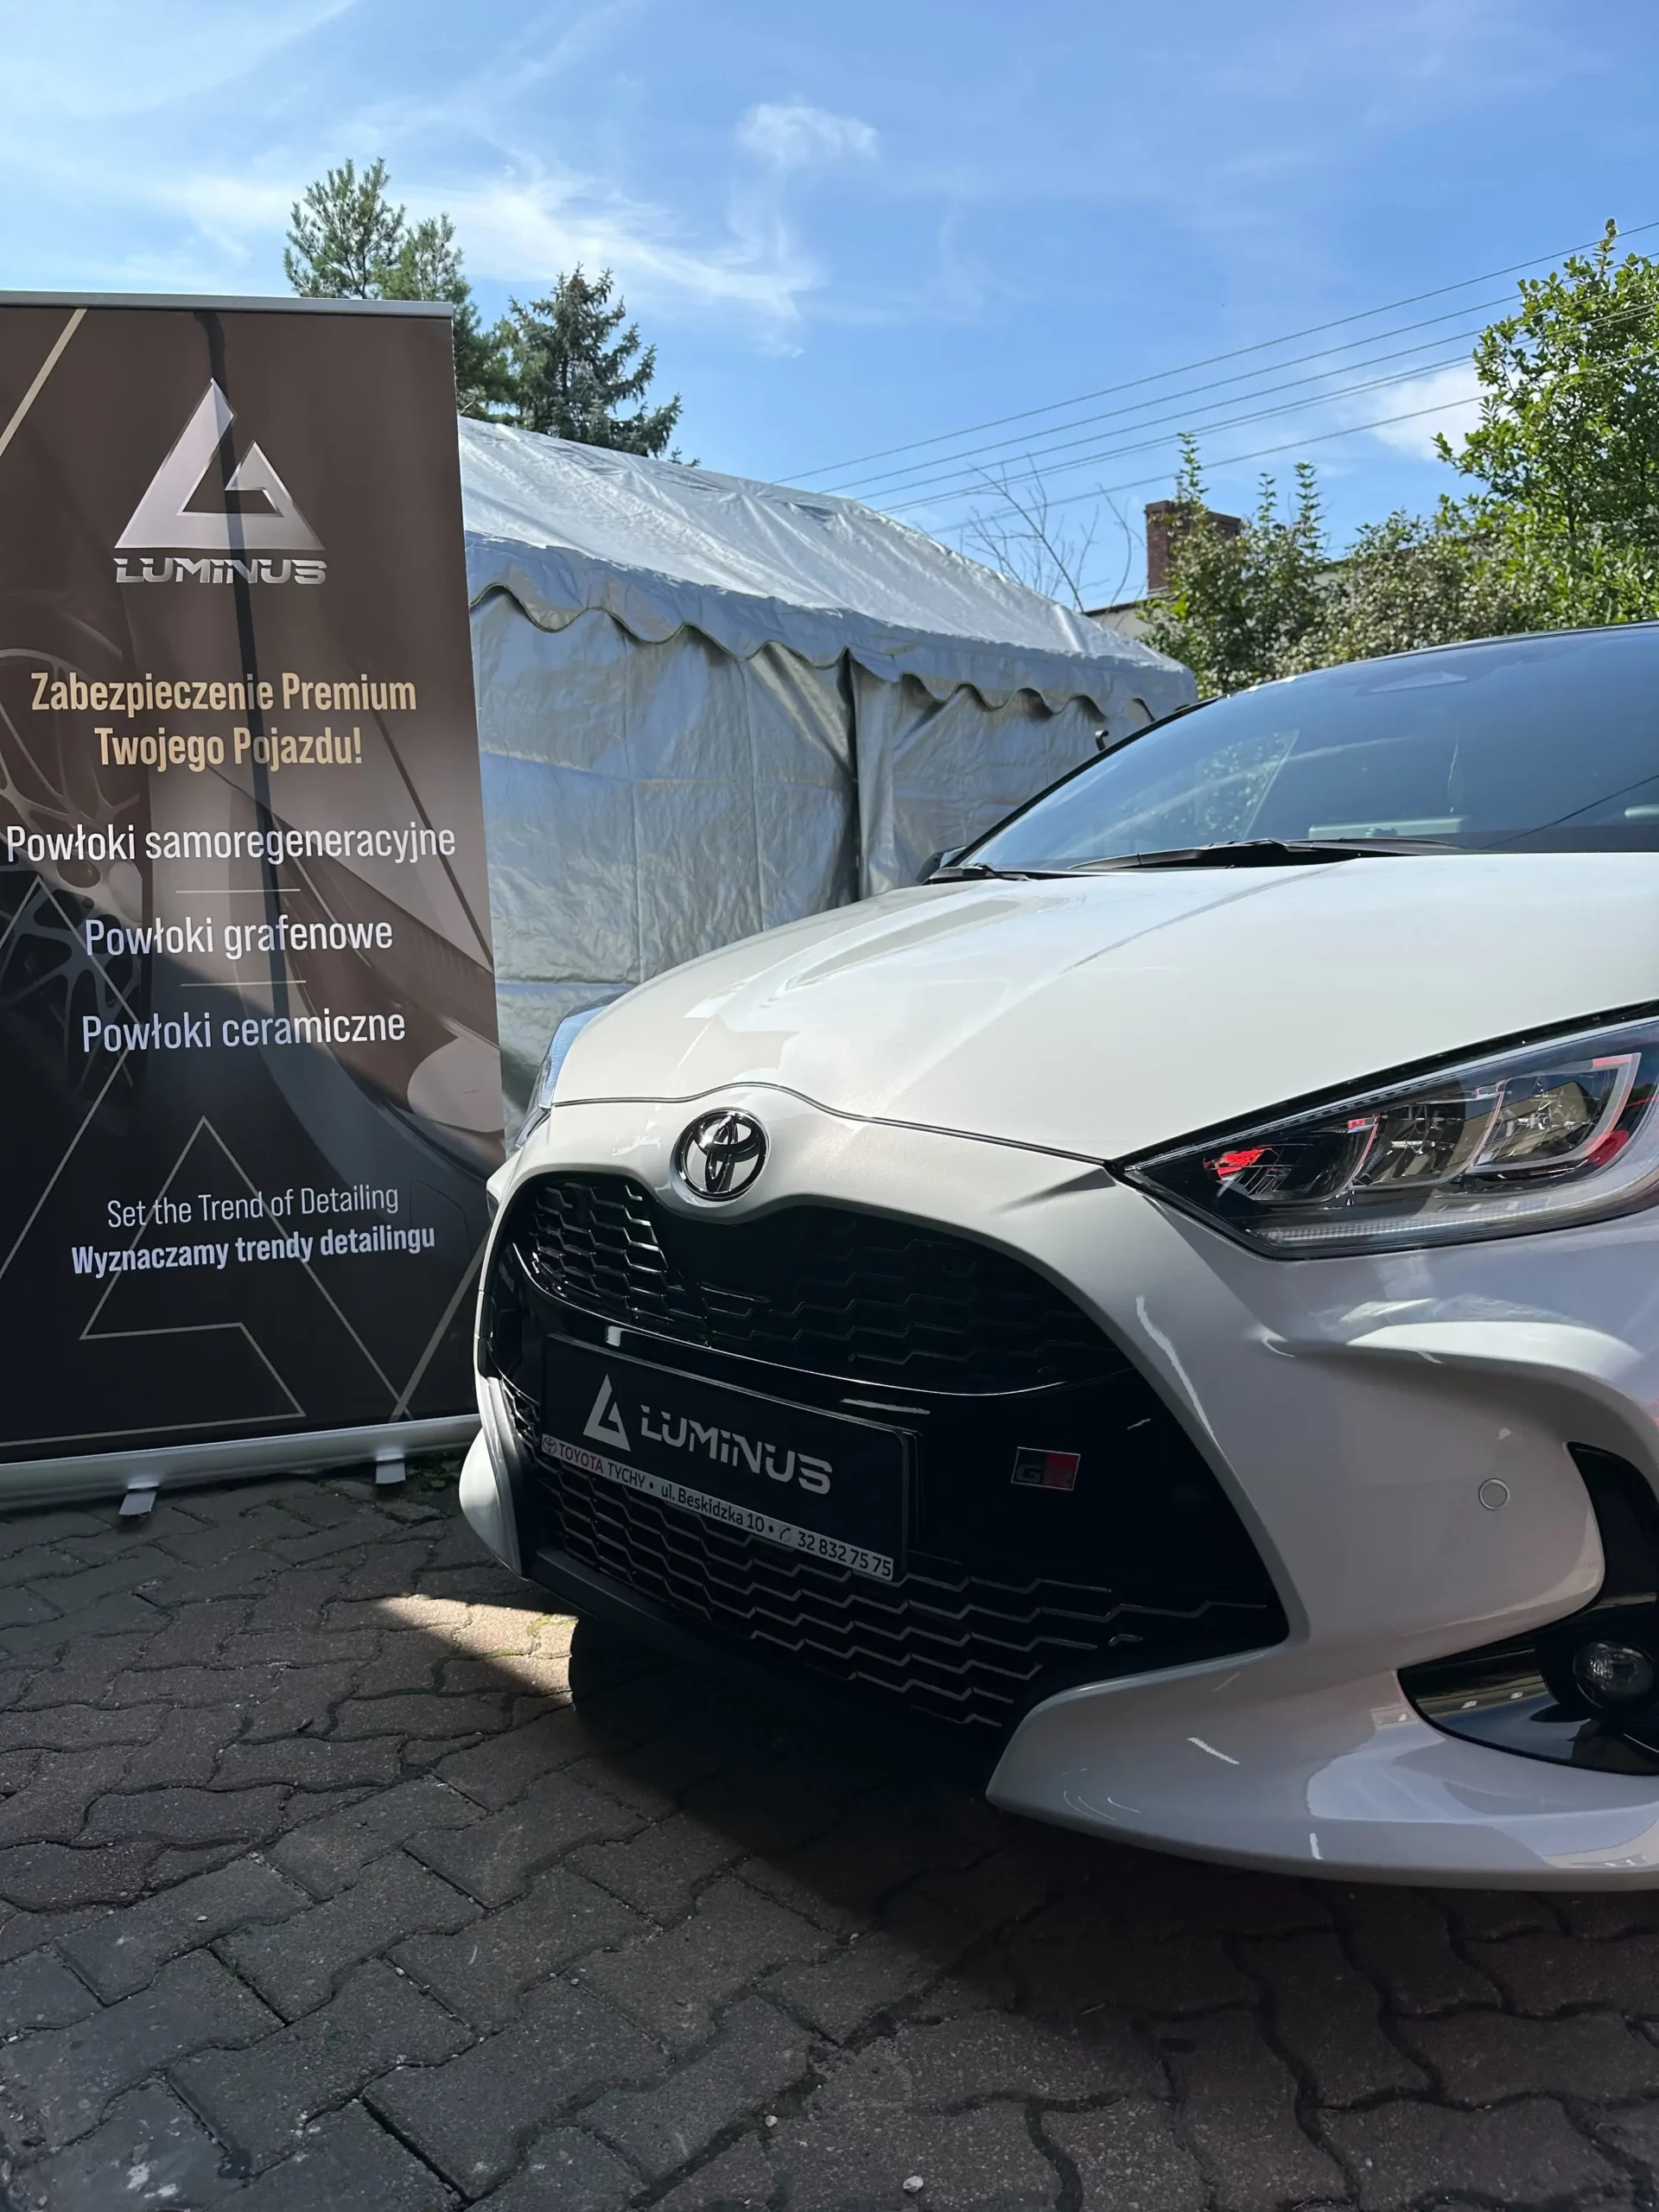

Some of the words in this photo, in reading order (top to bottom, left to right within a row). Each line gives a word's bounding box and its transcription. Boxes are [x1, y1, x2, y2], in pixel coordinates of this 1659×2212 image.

[114, 557, 327, 585] LUMINUS
[31, 672, 274, 718] Zabezpieczenie
[282, 672, 416, 710] Premium
[94, 727, 225, 772] Twojego
[234, 727, 362, 772] Pojazdu!
[7, 823, 136, 862] Powłoki
[145, 821, 456, 865] samoregeneracyjne
[86, 917, 213, 956] Powłoki
[224, 914, 393, 959] grafenowe
[82, 1012, 212, 1052] Powłoki
[222, 1008, 406, 1046] ceramiczne
[107, 1199, 145, 1228] Set
[153, 1197, 192, 1225] the
[198, 1192, 264, 1221] Trend
[270, 1189, 294, 1216] of
[301, 1184, 399, 1214] Detailing
[72, 1240, 229, 1278] Wyznaczamy
[235, 1230, 314, 1269] trendy
[320, 1224, 435, 1262] detailingu
[639, 1404, 833, 1495] LUMINUS
[558, 1442, 604, 1474] TOYOTA
[607, 1462, 645, 1488] TYCHY
[661, 1484, 676, 1501] ul.
[678, 1490, 744, 1526] Beskidzka
[747, 1514, 765, 1532] 10
[798, 1531, 815, 1548] 32
[819, 1537, 848, 1560] 832
[850, 1548, 869, 1569] 75
[872, 1555, 892, 1577] 75
